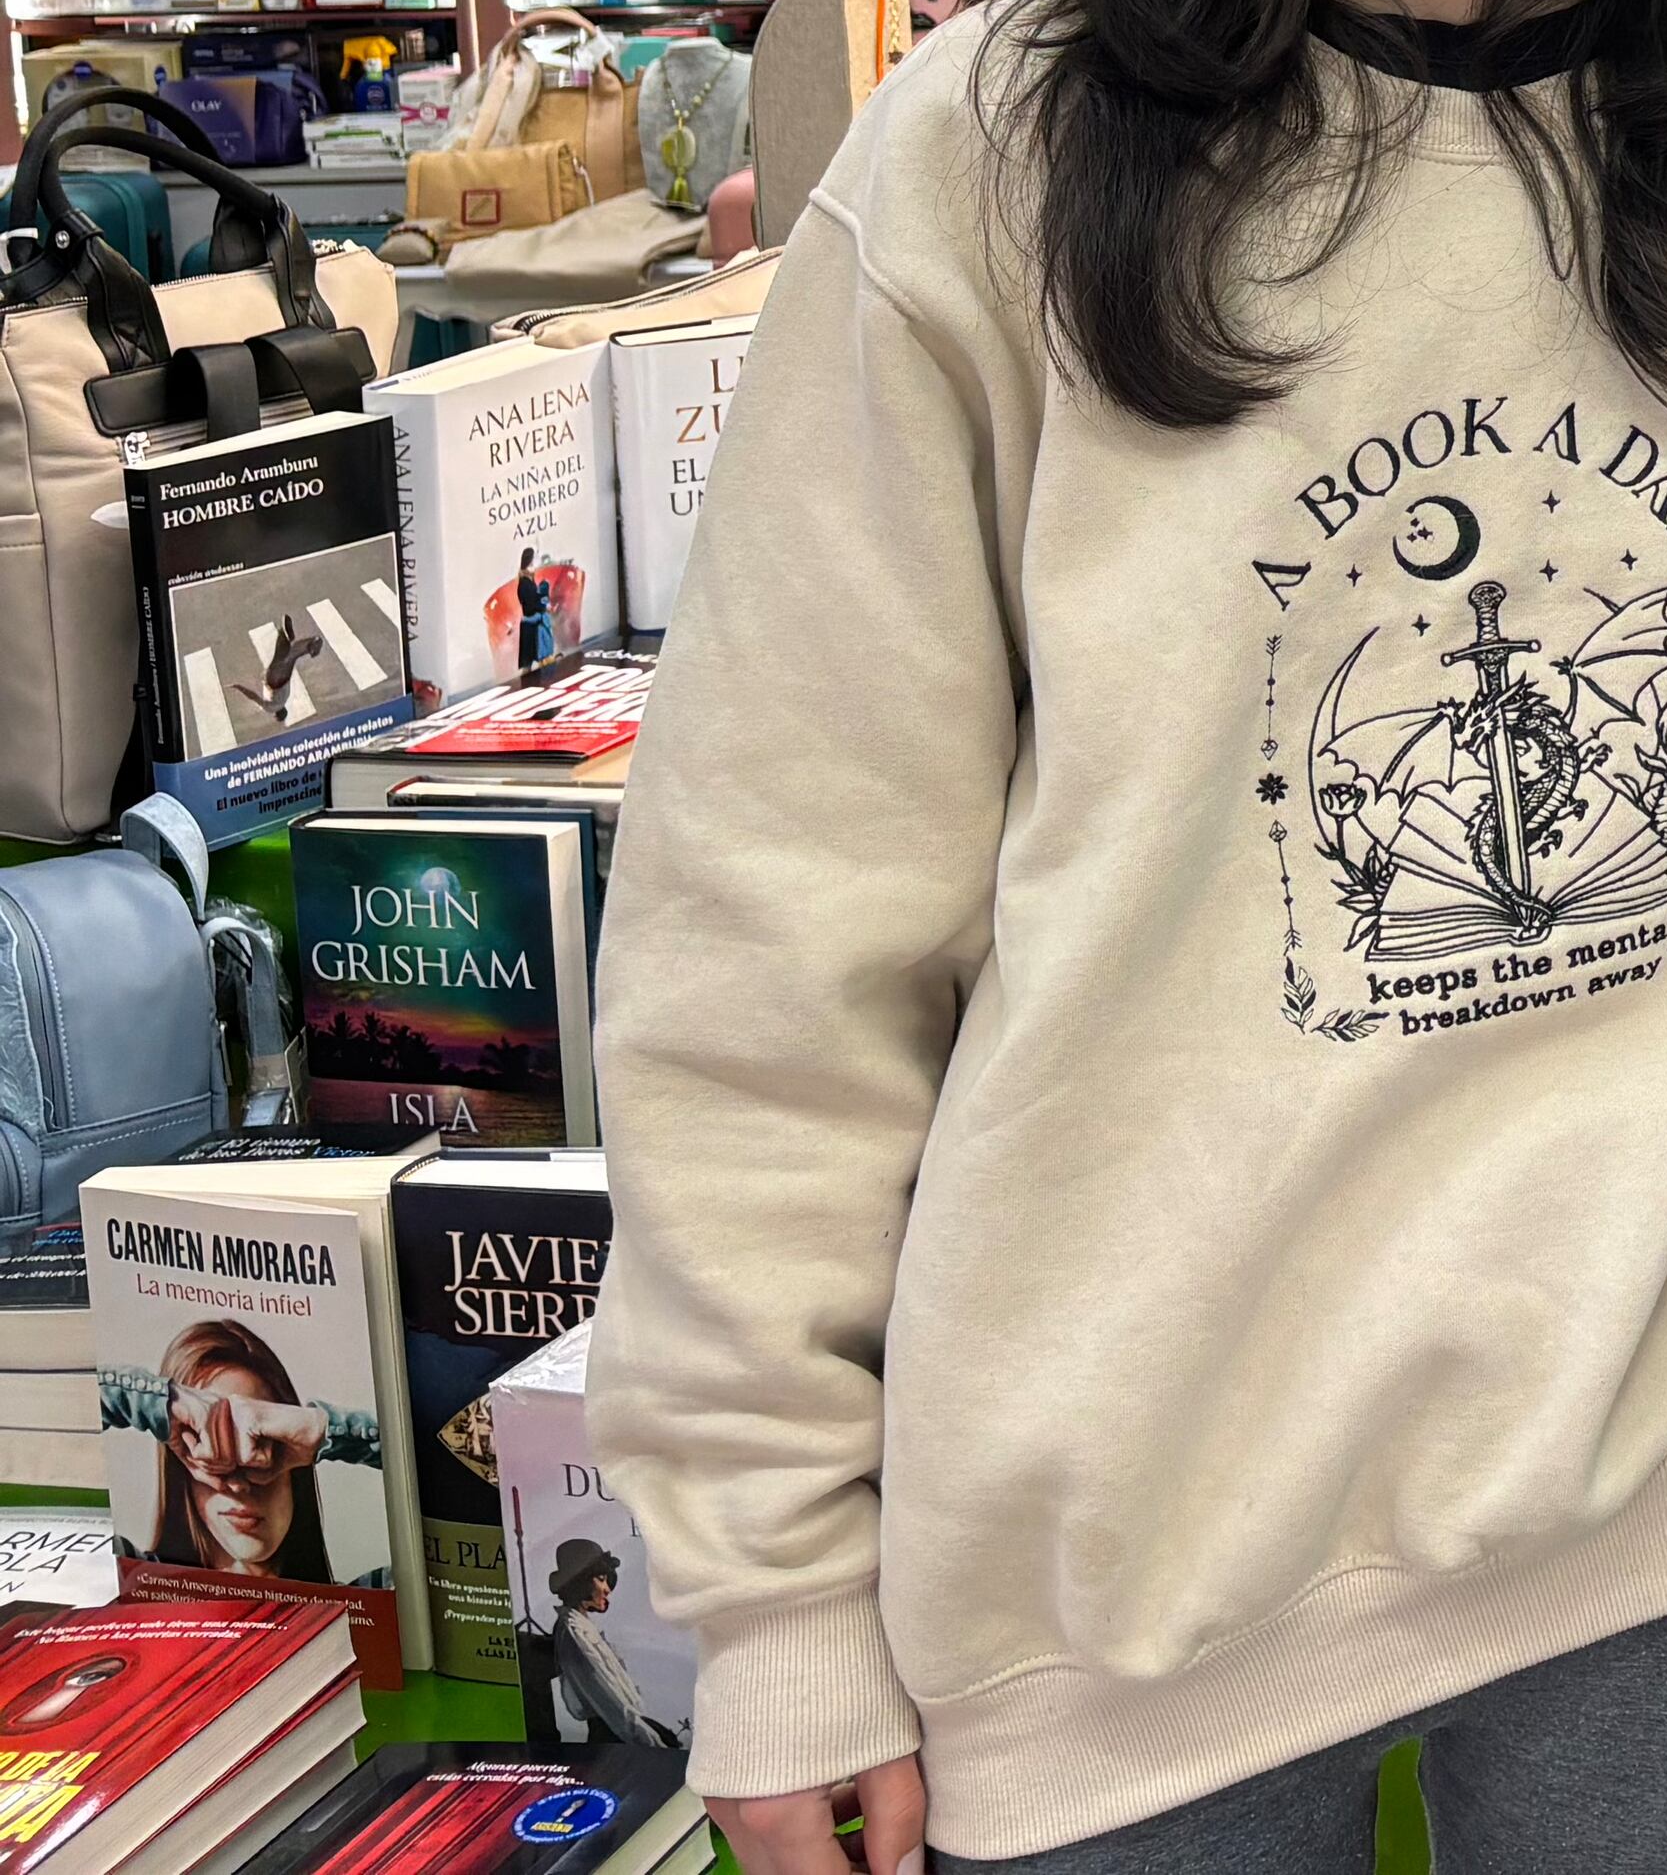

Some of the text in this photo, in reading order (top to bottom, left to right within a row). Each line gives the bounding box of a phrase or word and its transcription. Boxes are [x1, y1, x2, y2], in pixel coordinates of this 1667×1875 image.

[191, 101, 222, 112] OLAY
[469, 382, 589, 441] ANA LENA
[489, 420, 575, 468] RIVERA
[160, 457, 319, 501] Fernando Aramburu
[480, 454, 585, 504] LA NIÑA DEL
[488, 479, 579, 526] SOMBRERO
[1252, 559, 1311, 611] A
[1295, 396, 1511, 540] BOOK
[1534, 402, 1581, 466] A
[163, 478, 324, 530] HOMBRE CAÍDO
[513, 515, 557, 541] AZUL
[205, 715, 394, 782] Una inolvidable colección de relatos
[227, 755, 305, 790] de FERNANDO
[217, 771, 316, 812] El nuevo libro de
[351, 885, 480, 935] JOHN
[310, 940, 535, 990] GRISHAM
[1367, 965, 1478, 1005] keeps
[1492, 953, 1554, 985] the
[1399, 953, 1662, 1037] breakdown away
[389, 1092, 478, 1134] ISLA
[107, 1218, 204, 1272] CARMEN
[213, 1234, 336, 1287] AMORAGA
[137, 1273, 312, 1318] La memoria infiel
[228, 1586, 263, 1600] cuenta
